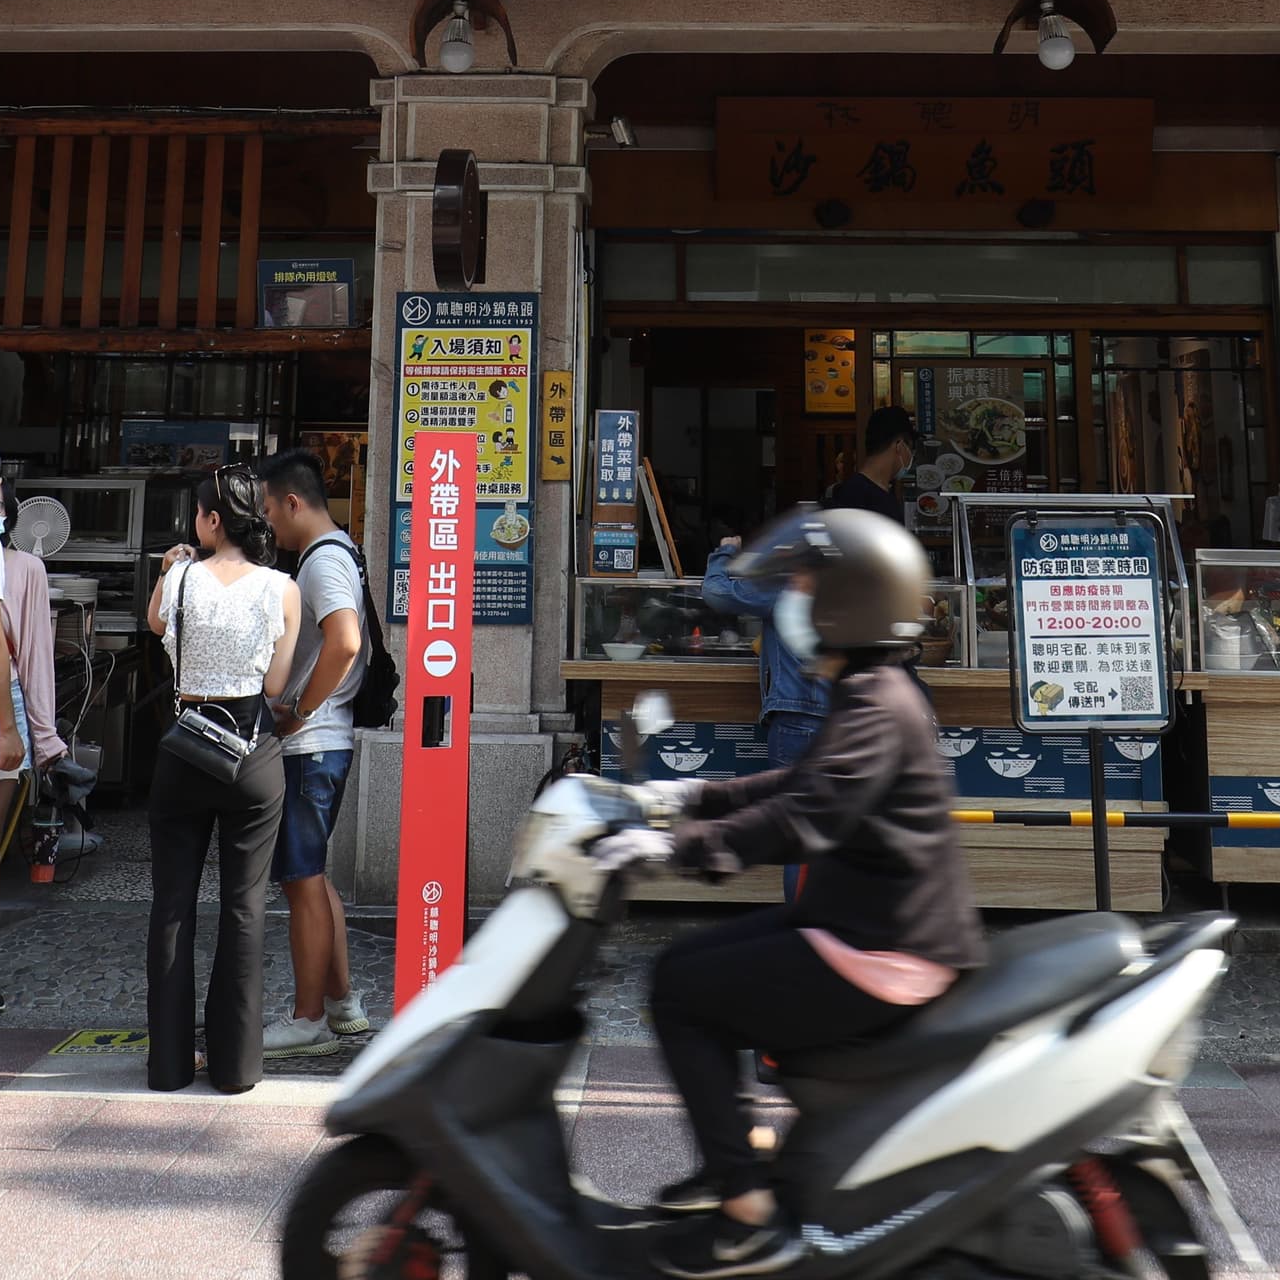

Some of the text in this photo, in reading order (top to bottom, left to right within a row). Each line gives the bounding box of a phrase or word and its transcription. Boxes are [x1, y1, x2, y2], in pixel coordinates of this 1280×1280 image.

[769, 136, 1097, 196] 沙鍋魚頭
[274, 271, 337, 282] 排隊內用燈號
[436, 301, 533, 317] 林聰明沙鍋魚頭
[431, 339, 501, 355] 入場須知
[549, 381, 566, 448] 外帶區
[616, 415, 633, 483] 外帶菜單
[600, 439, 615, 482] 請自取
[986, 469, 1025, 482] 三倍券
[427, 449, 461, 630] 外帶區 出口
[1023, 559, 1148, 576] 防疫期間營業時間
[1050, 585, 1123, 596] 因應防疫時期
[1026, 600, 1149, 612] 門市營業時間將調整為
[1073, 681, 1099, 694] 宅配
[1068, 696, 1106, 709] 傳送門
